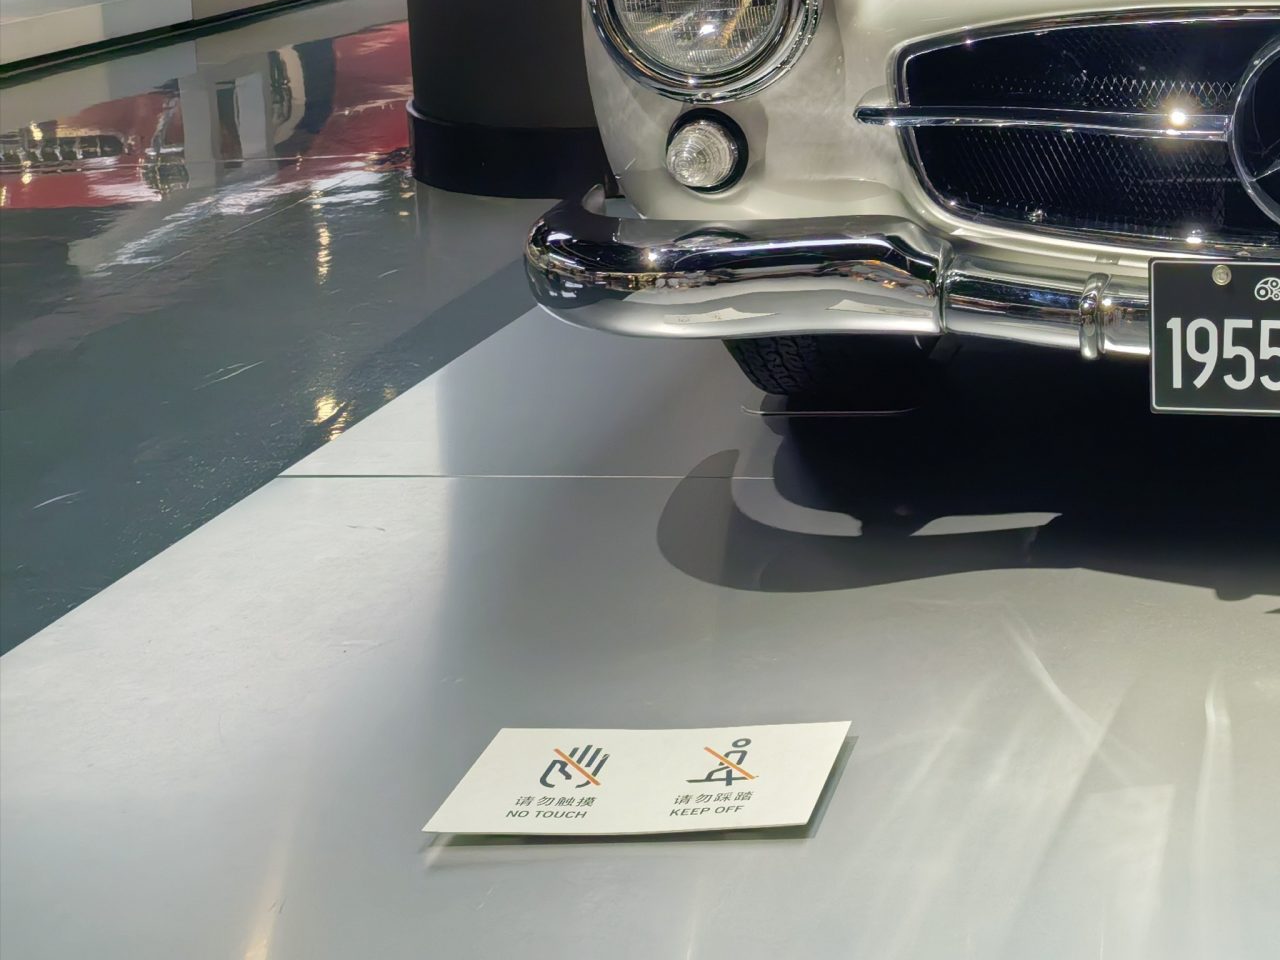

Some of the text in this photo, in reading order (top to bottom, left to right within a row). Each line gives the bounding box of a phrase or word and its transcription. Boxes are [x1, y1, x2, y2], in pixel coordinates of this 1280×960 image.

[515, 796, 596, 807] 请勿触摸
[674, 791, 753, 805] 请勿踩踏
[505, 810, 588, 818] NO TOUCH
[669, 805, 745, 816] KEEP OFF
